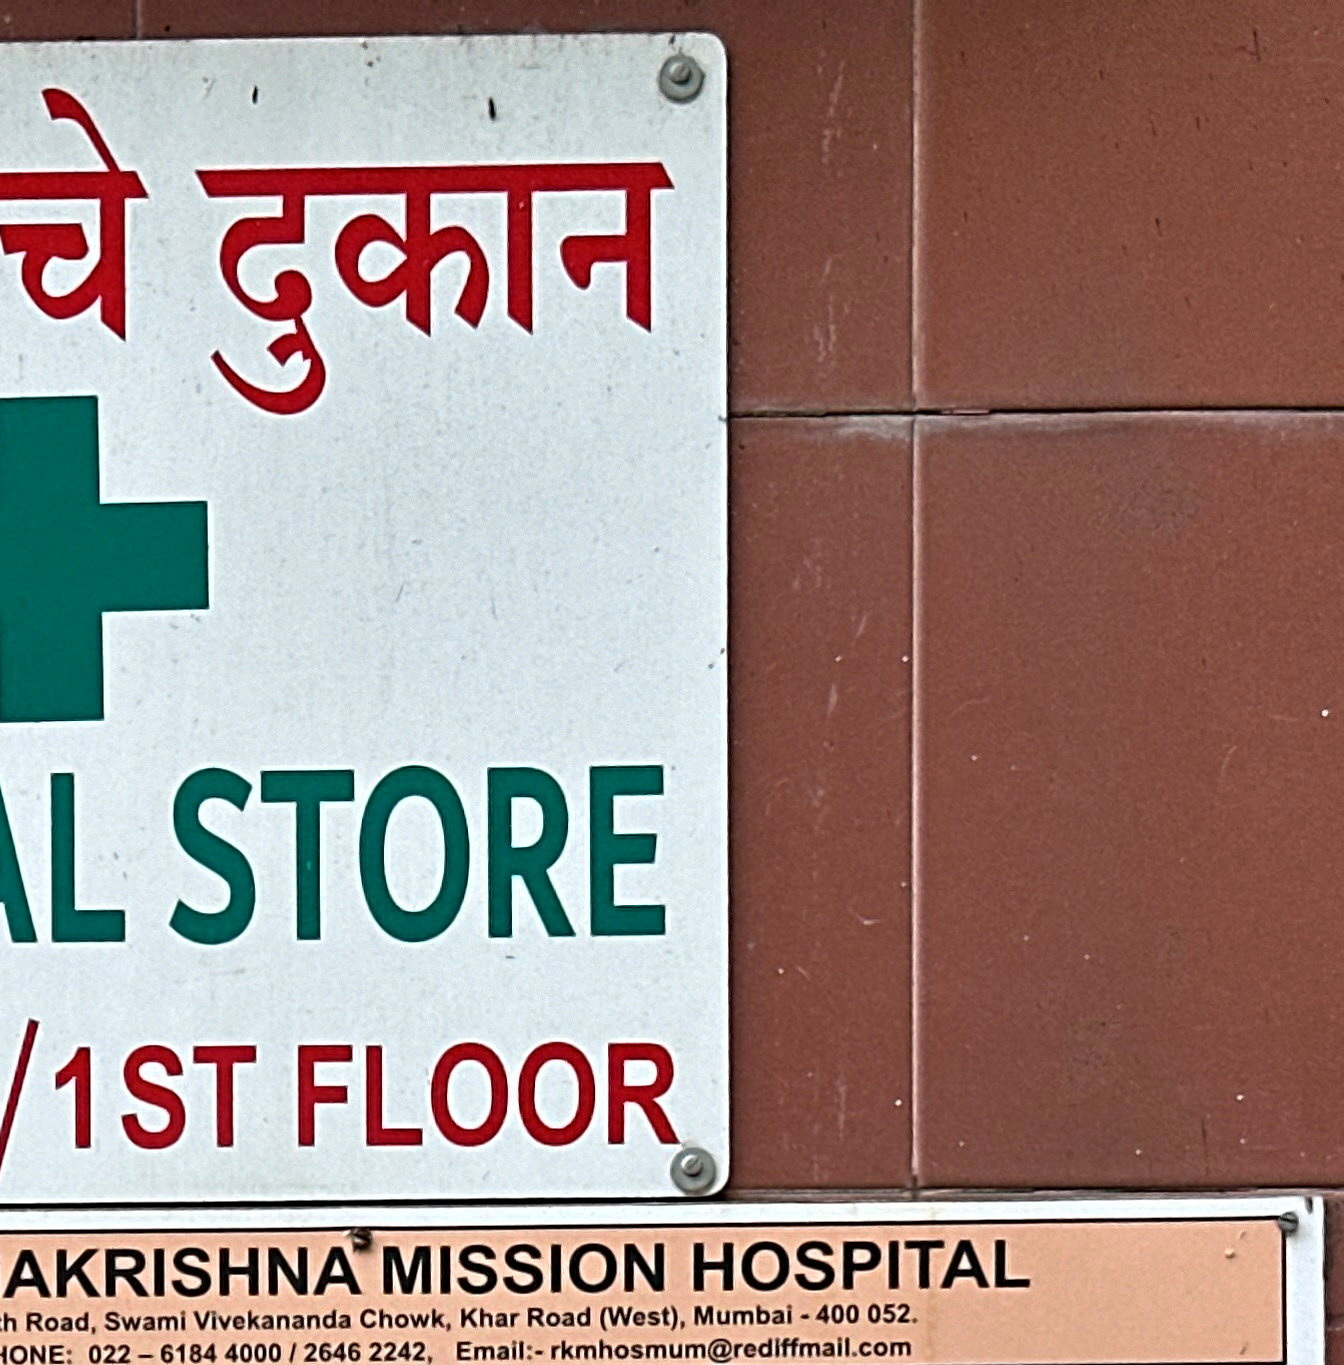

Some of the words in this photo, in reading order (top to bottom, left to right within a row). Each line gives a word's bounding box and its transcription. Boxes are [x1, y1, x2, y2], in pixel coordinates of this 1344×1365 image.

[199, 163, 670, 414] दुकान
[174, 768, 661, 941] STORE
[299, 1042, 676, 1146] FLOOR
[383, 1243, 664, 1294] MISSION
[694, 1240, 1030, 1291] HOSPITAL
[27, 1312, 95, 1334] Road,
[105, 1311, 185, 1331] Swami
[193, 1310, 351, 1330] Vivekananda
[360, 1309, 451, 1331] Chowk,
[461, 1308, 520, 1327] Khar
[528, 1307, 590, 1327] Road
[600, 1306, 685, 1331] (West),
[695, 1305, 792, 1325] Mumbai
[816, 1305, 859, 1324] 400
[868, 1304, 917, 1323] 052.
[89, 1345, 130, 1364] 022
[161, 1343, 217, 1363] 6184
[225, 1343, 281, 1362] 4000
[304, 1342, 360, 1362] 2646
[369, 1342, 432, 1364] 2242,
[457, 1341, 543, 1360] Email:-
[551, 1337, 911, 1363] rkmhosmum@rediffmail.com
